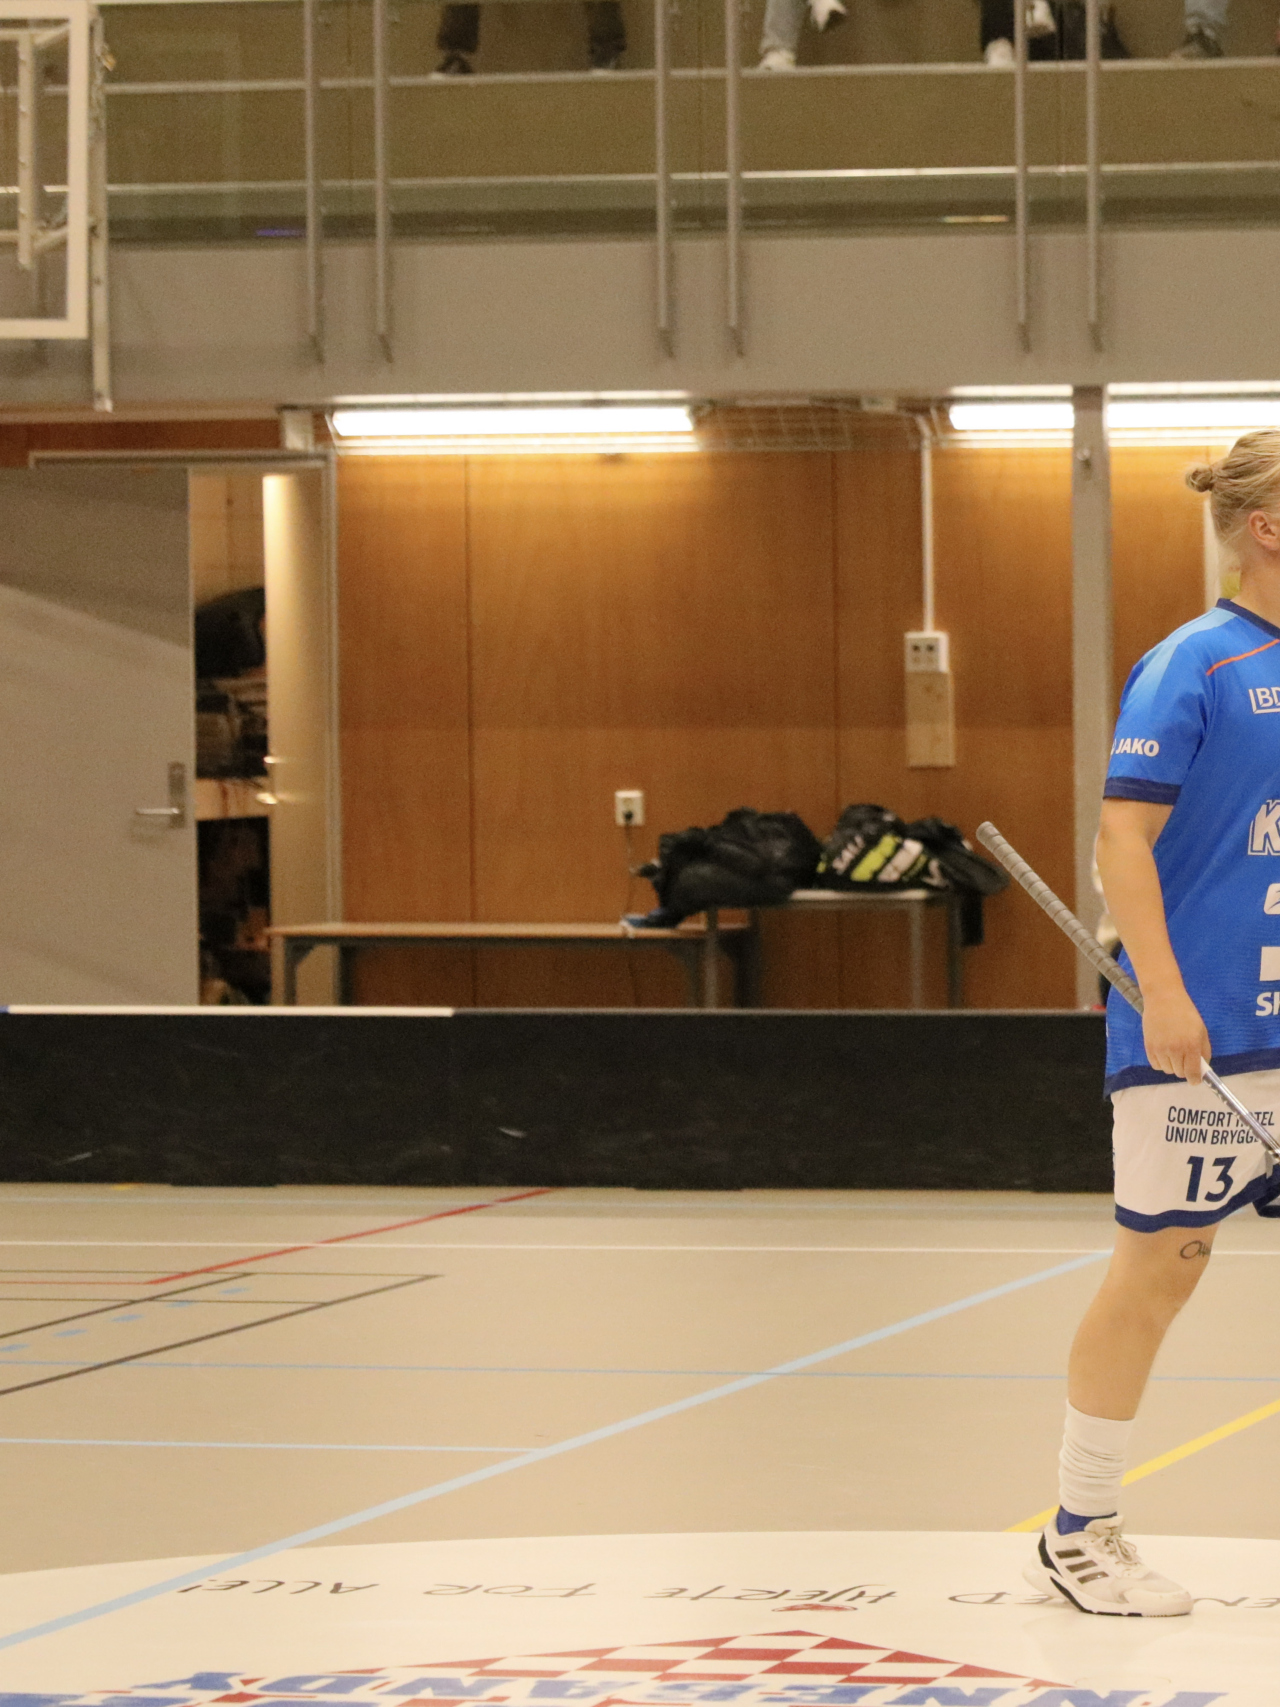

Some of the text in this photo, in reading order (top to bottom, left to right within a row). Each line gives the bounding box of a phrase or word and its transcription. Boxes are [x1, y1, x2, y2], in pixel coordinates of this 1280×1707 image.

[1115, 737, 1160, 758] JAKO
[1167, 1105, 1233, 1127] COMFORT
[1165, 1125, 1208, 1144] UNION
[1185, 1155, 1238, 1203] 13
